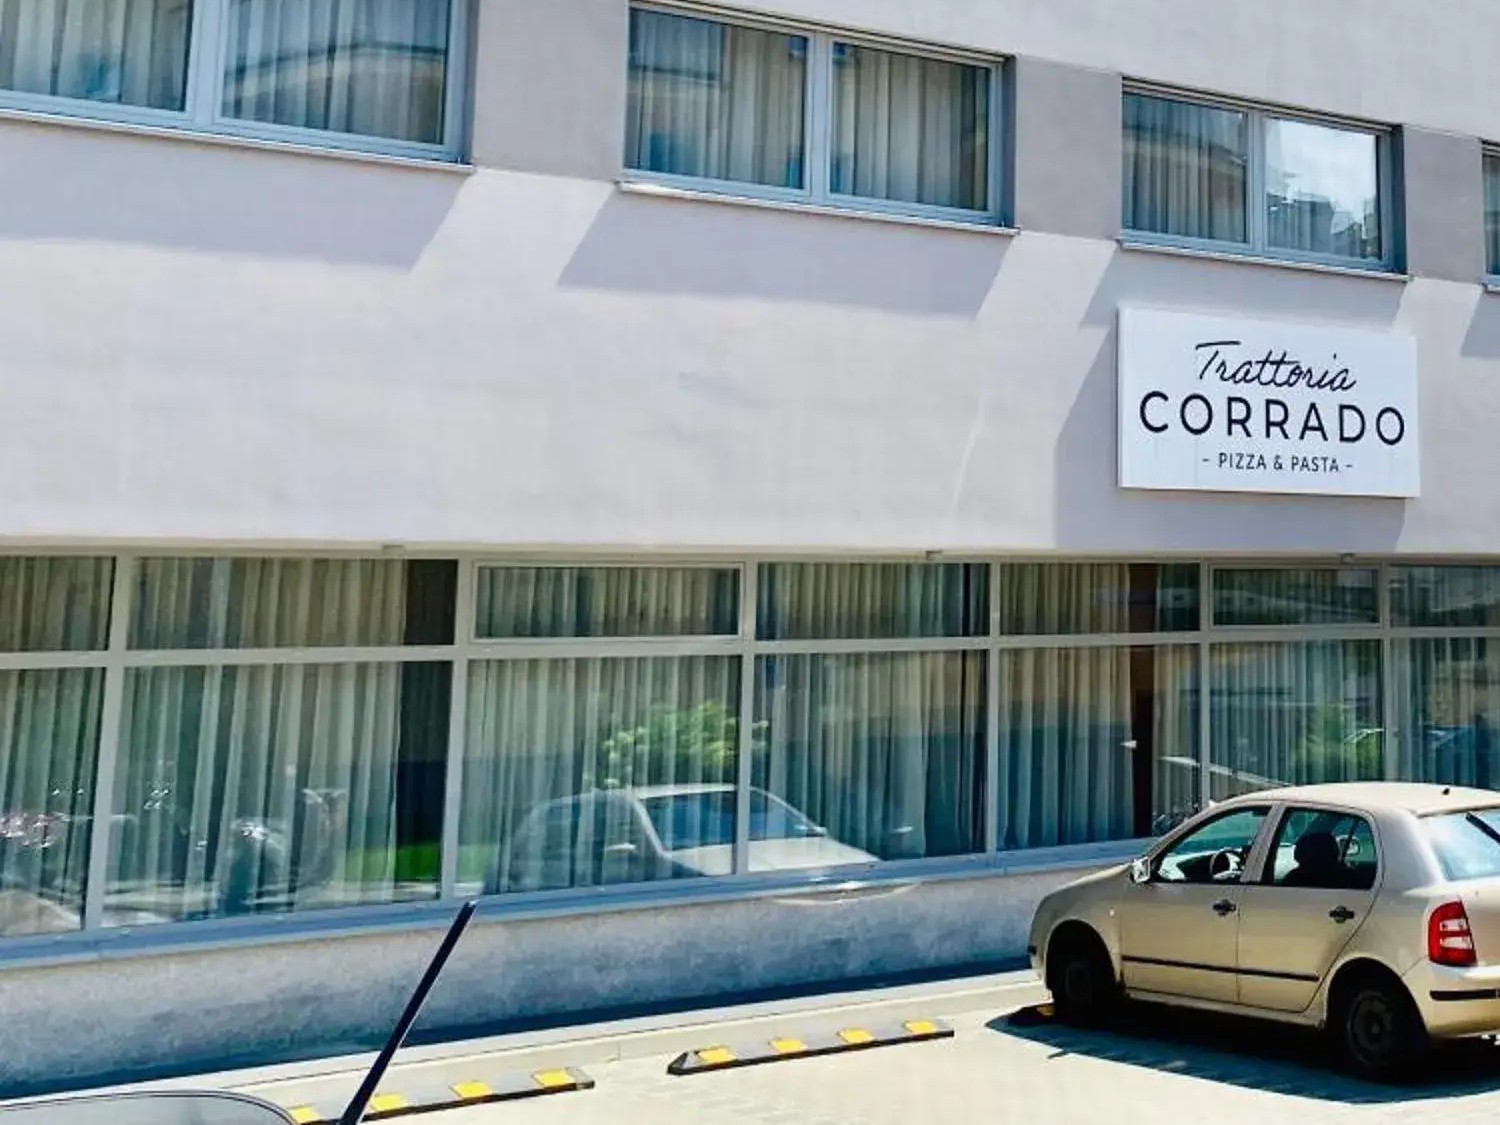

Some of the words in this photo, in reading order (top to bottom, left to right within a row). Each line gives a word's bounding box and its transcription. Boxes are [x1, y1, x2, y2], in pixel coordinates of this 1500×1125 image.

[1195, 340, 1357, 392] Trattoria
[1139, 391, 1406, 446] CORRADO
[1218, 452, 1267, 471] PIZZA
[1273, 454, 1284, 471] &
[1290, 456, 1340, 473] PASTA
